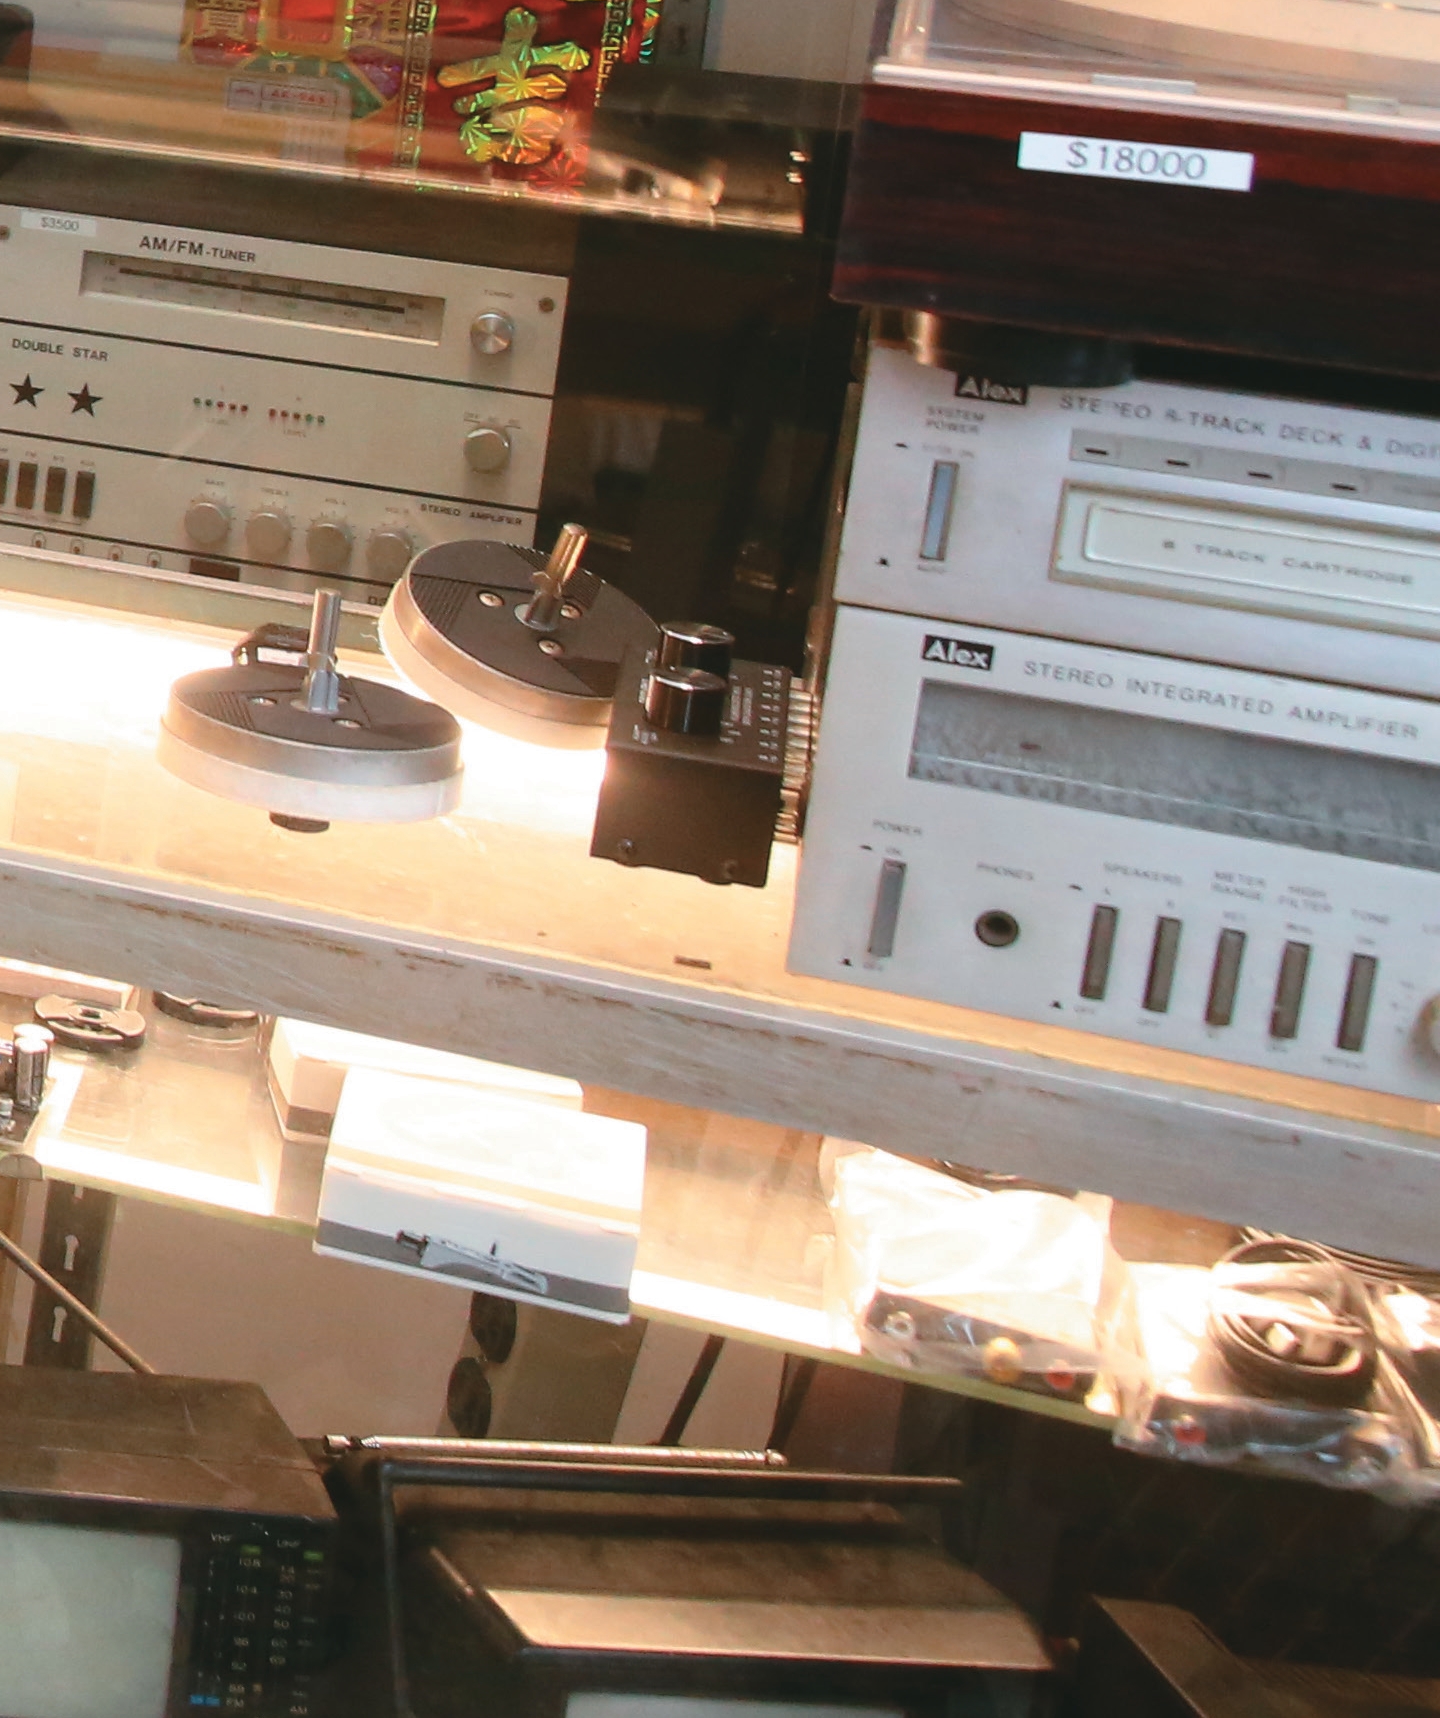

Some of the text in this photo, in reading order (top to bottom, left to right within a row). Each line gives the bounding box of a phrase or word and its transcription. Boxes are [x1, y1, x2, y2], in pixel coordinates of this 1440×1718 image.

[1066, 143, 1208, 181] $18000
[41, 216, 80, 232] $3500
[12, 338, 109, 362] DOUBLE STAR
[958, 375, 1024, 403] Alex
[927, 405, 984, 421] SYSTEM
[1060, 393, 1152, 419] STEEO
[1279, 423, 1343, 447] DECK
[1357, 435, 1372, 451] &
[926, 419, 979, 434] POWER
[420, 502, 523, 527] STEREO AMPLIFIER
[1195, 543, 1266, 564] TRACK
[1282, 556, 1414, 585] CARTRIDGE
[924, 638, 991, 669] Alex
[1023, 658, 1420, 742] STEREO INTEGRATED AMPLIFIER
[873, 819, 923, 836] POWER
[977, 860, 1035, 881] PHONES
[1103, 861, 1182, 886] SPEAKERS
[1215, 870, 1266, 888] METER
[1210, 881, 1262, 902] RANGE
[1278, 895, 1333, 914] FILTER
[1351, 907, 1391, 926] TONE
[211, 1532, 232, 1544] VHF
[236, 1585, 258, 1595] 104
[226, 1698, 244, 1708] FM
